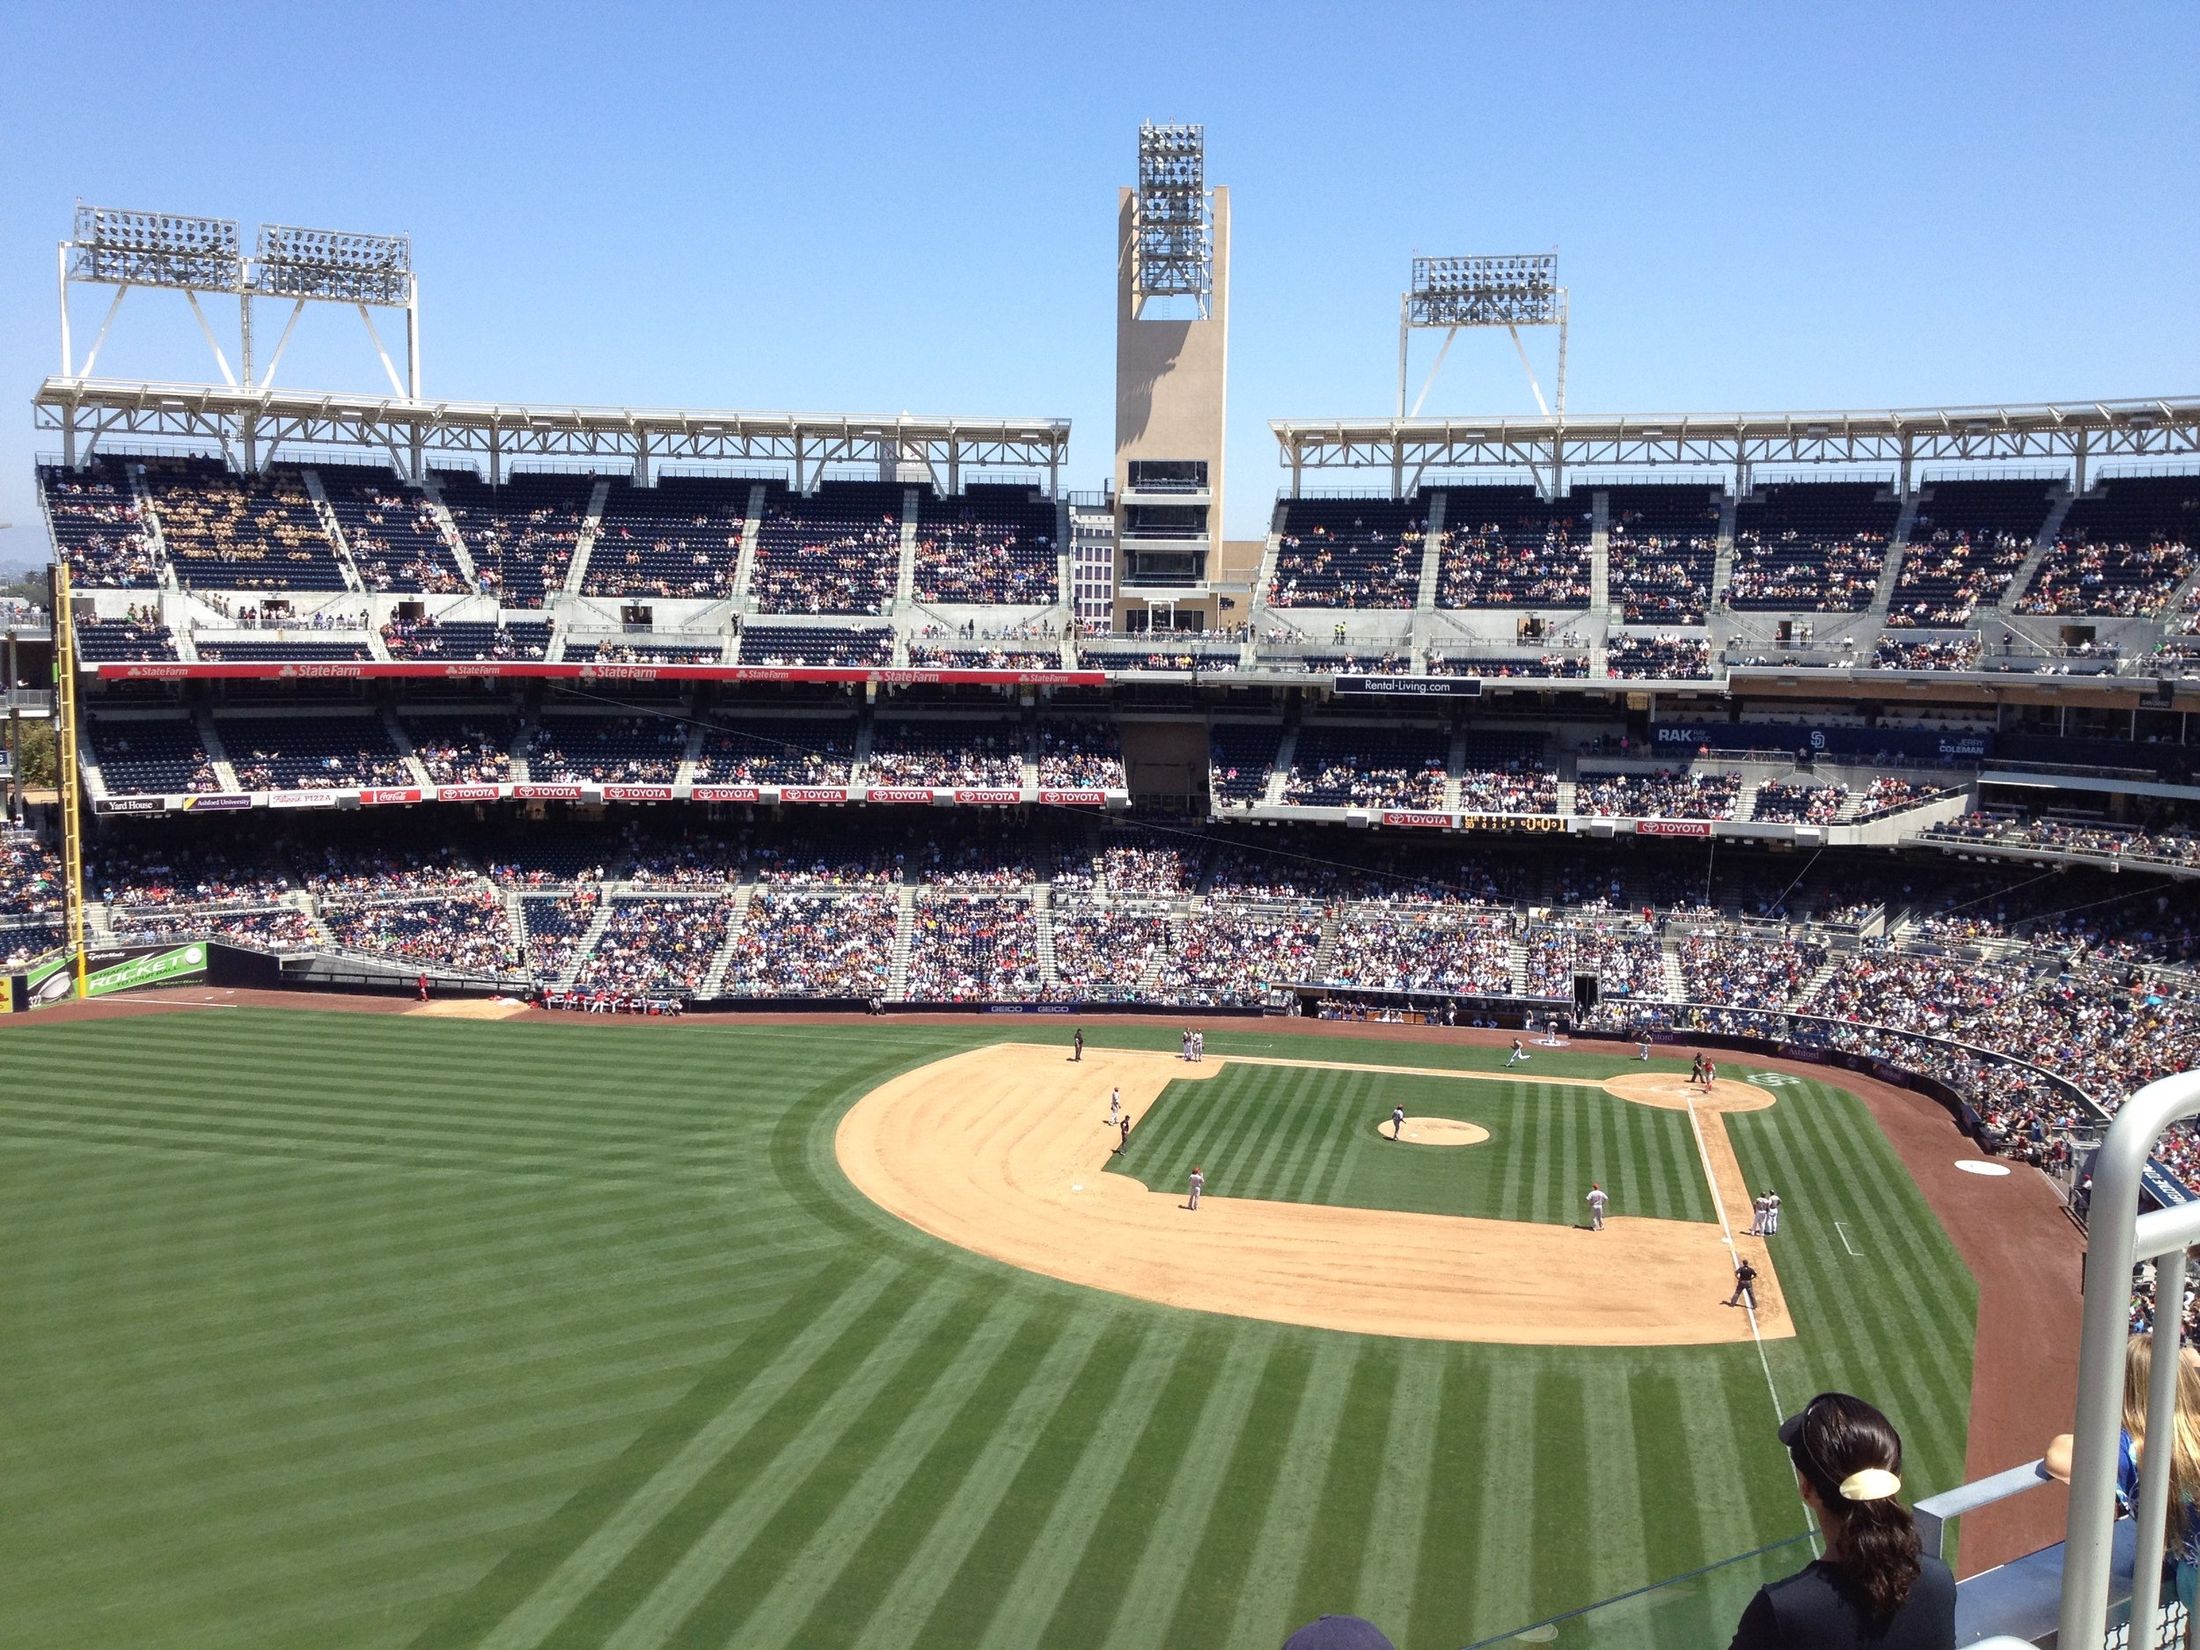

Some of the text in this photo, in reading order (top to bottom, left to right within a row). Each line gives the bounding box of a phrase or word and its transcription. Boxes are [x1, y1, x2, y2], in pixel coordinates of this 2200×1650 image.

[1365, 679, 1450, 693] Rental-Living.com
[1658, 729, 1692, 742] RAK
[1939, 745, 1984, 755] COLEMAN
[458, 788, 496, 799] TOYOTA
[535, 786, 577, 797] TOYOTA
[626, 788, 667, 798] TOYOTA
[713, 788, 754, 799] TOYOTA
[801, 789, 843, 800] TOYOTA
[888, 790, 929, 801] TOYOTA
[974, 791, 1015, 802] TOYOTA
[197, 798, 250, 807] Ashford University
[304, 794, 331, 802] PIZZA
[1059, 792, 1100, 803] TOYOTA
[108, 800, 153, 810] Yard House
[1405, 814, 1447, 825] TOYOTA
[1660, 823, 1705, 833] TOYOTA
[87, 952, 125, 961] TaylorMade
[89, 952, 183, 991] ROCKET
[991, 1005, 1023, 1013] GEICO
[1037, 1005, 1069, 1013] GEICO
